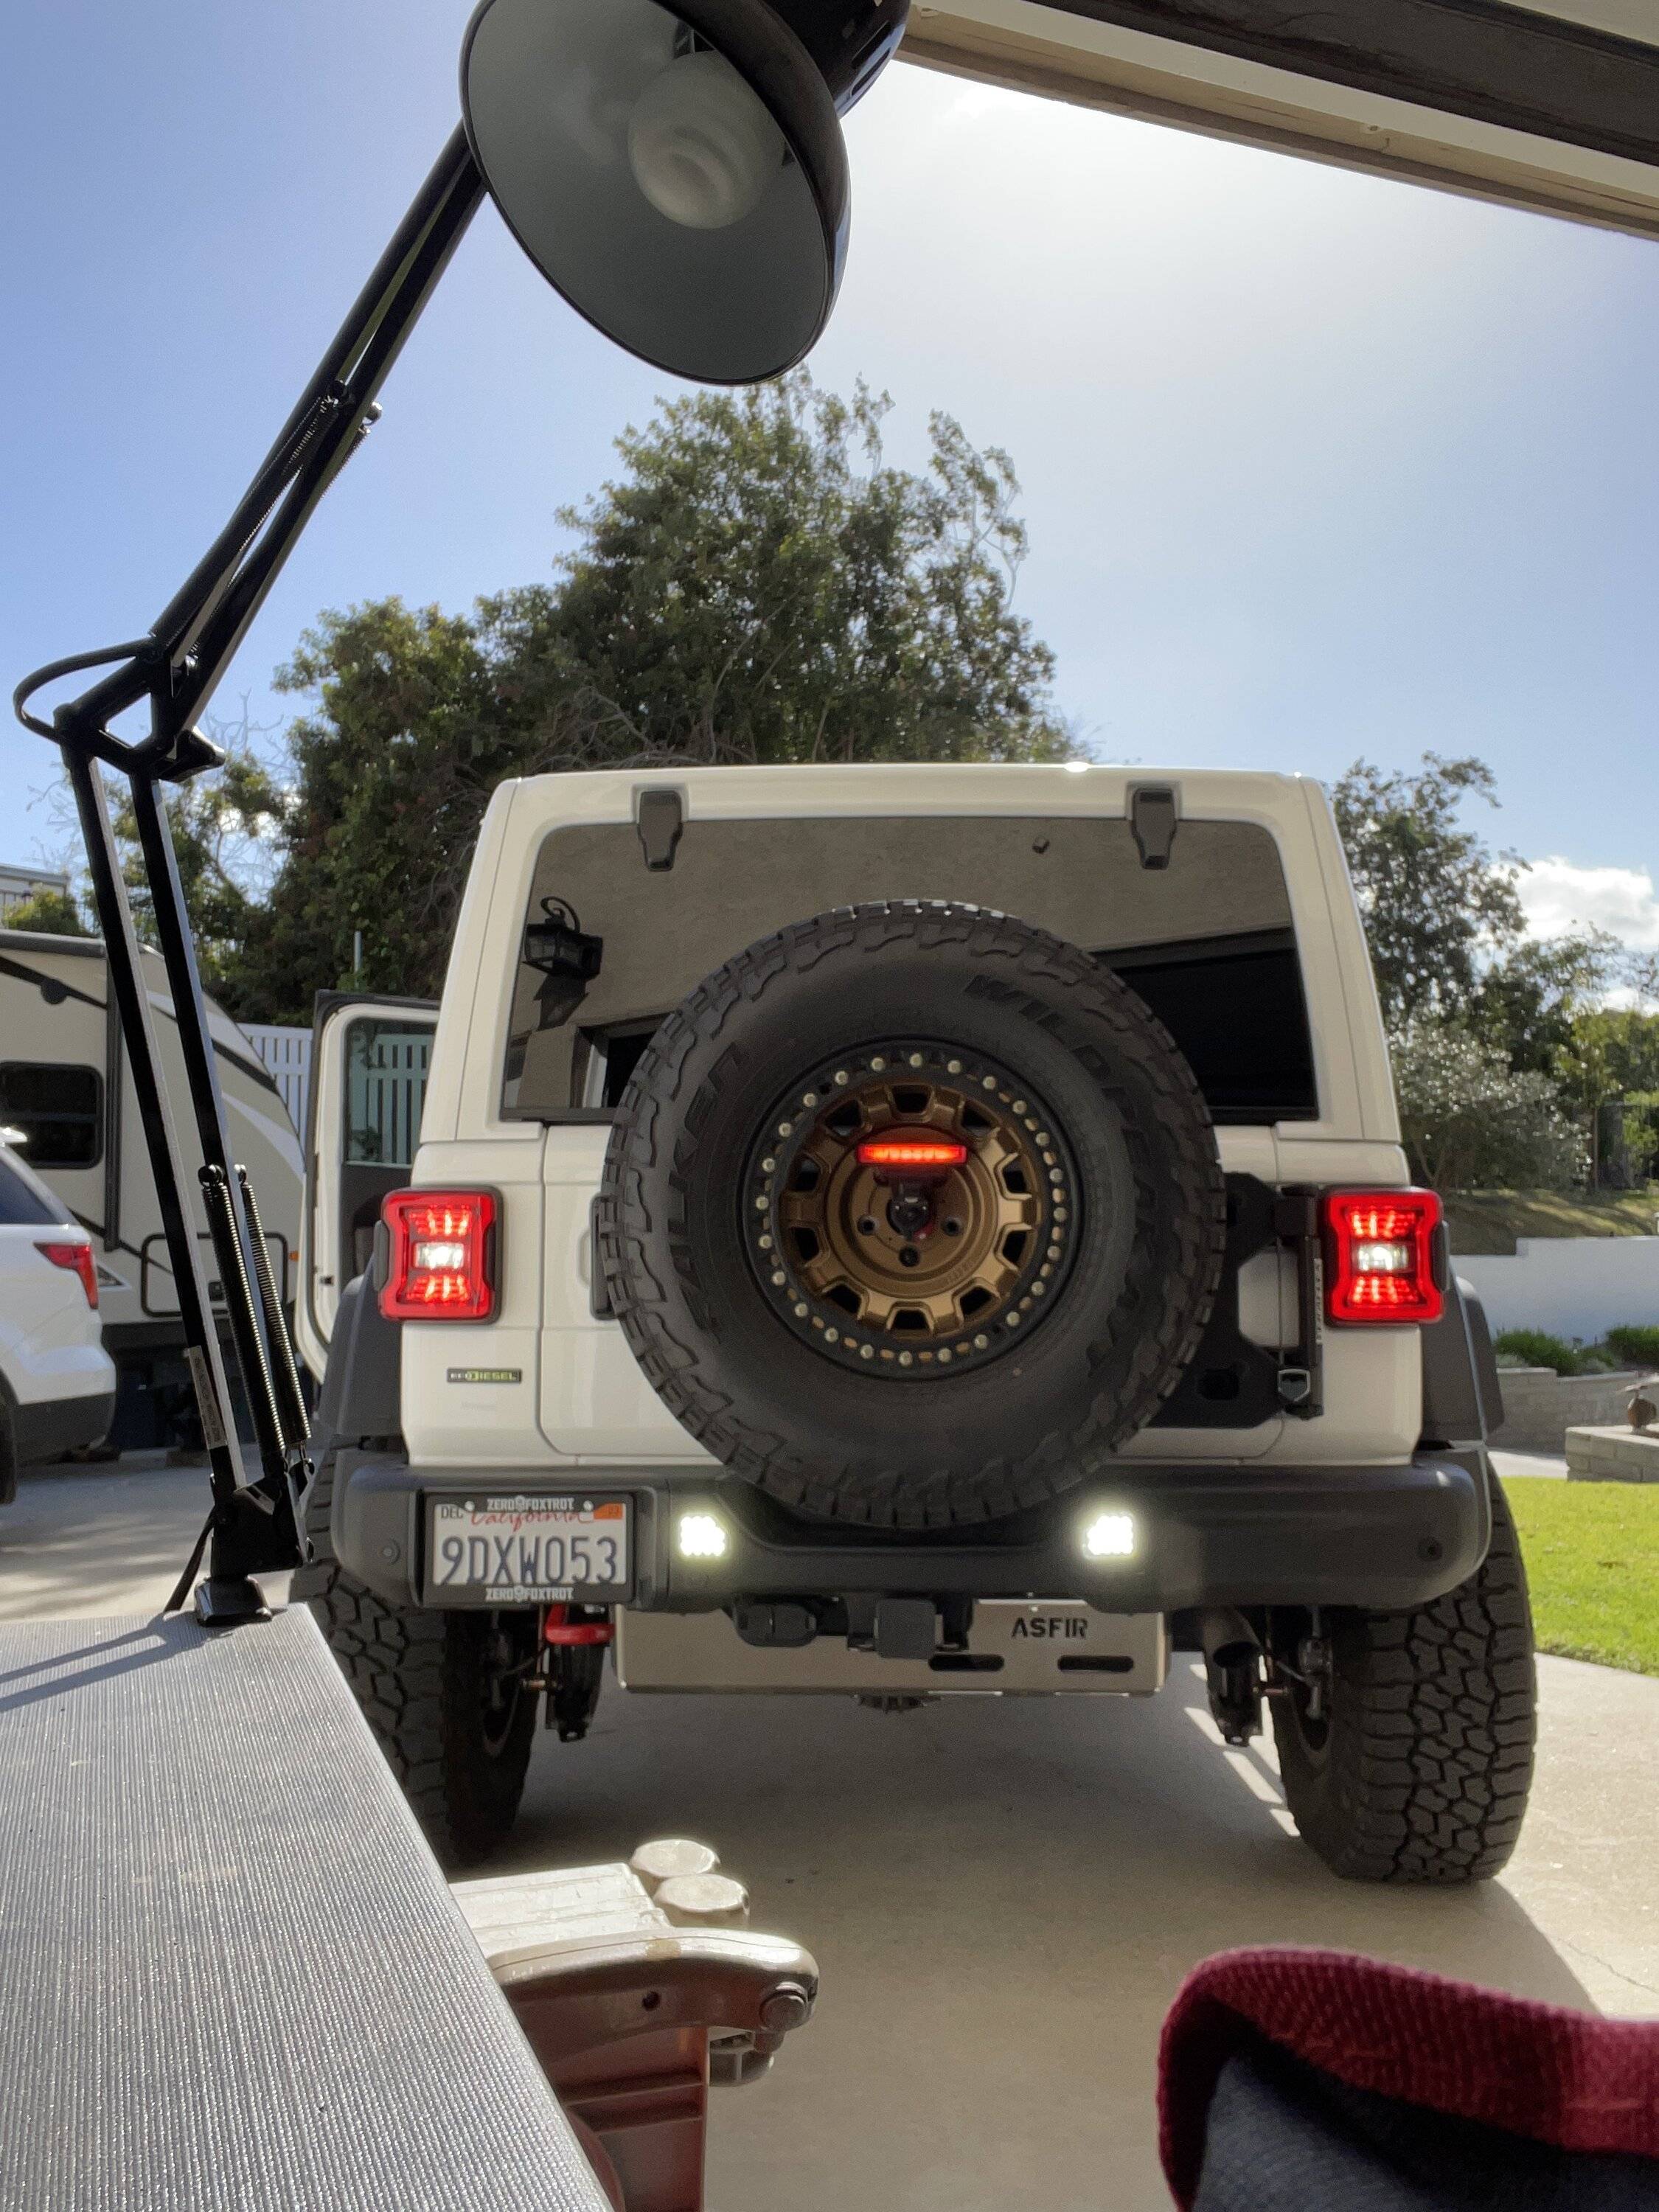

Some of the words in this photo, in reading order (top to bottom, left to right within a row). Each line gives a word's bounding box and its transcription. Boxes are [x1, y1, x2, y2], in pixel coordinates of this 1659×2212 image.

[668, 1043, 737, 1343] FALKEN
[441, 1506, 463, 1519] DEC
[442, 1536, 617, 1585] 9DXW053
[1012, 1617, 1088, 1638] ASFIR
